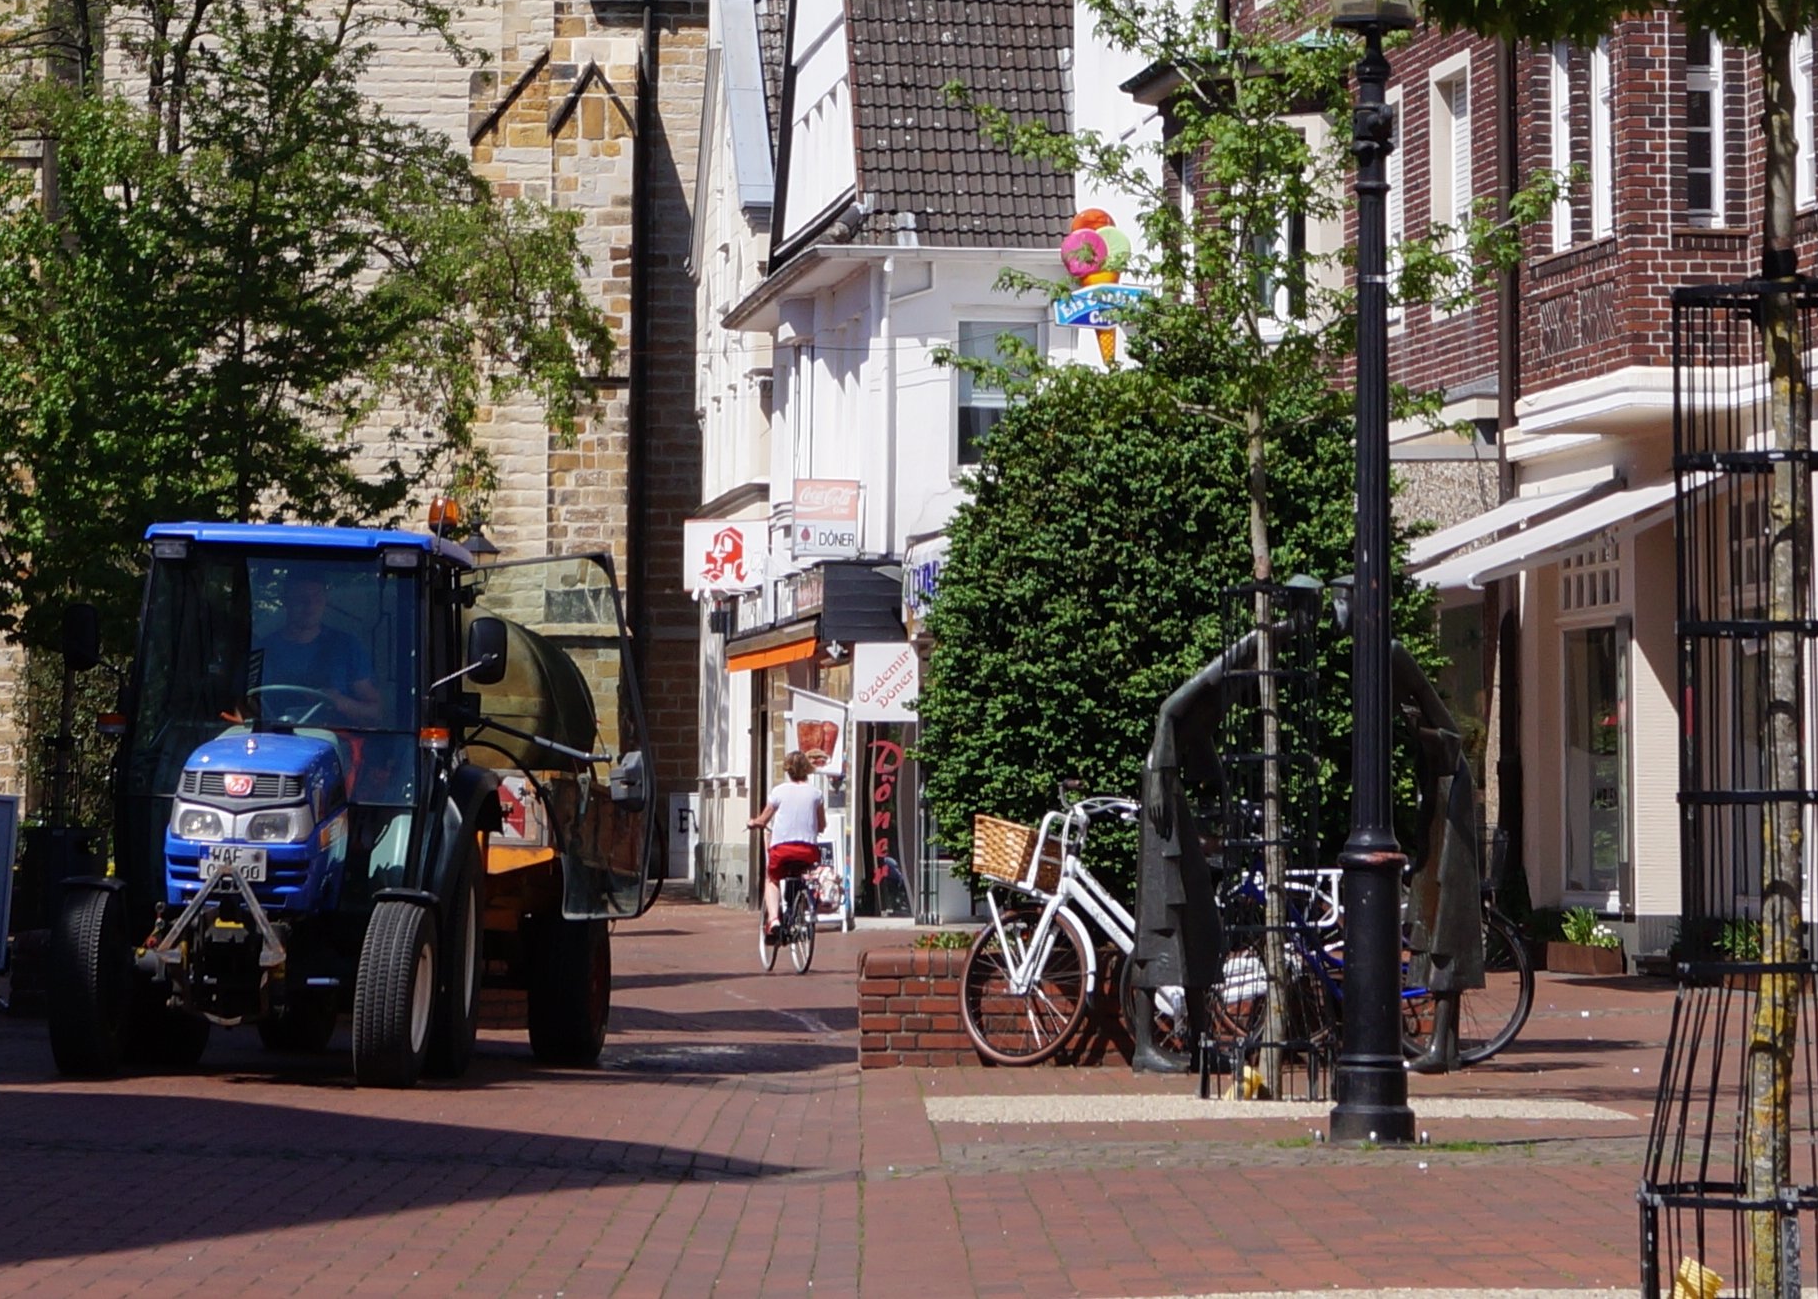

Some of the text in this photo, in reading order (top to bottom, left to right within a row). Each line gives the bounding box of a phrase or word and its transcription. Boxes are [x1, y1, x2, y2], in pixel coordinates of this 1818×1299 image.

[818, 529, 855, 547] DÖNER
[858, 650, 910, 703] Özdemir
[868, 740, 904, 885] Döner
